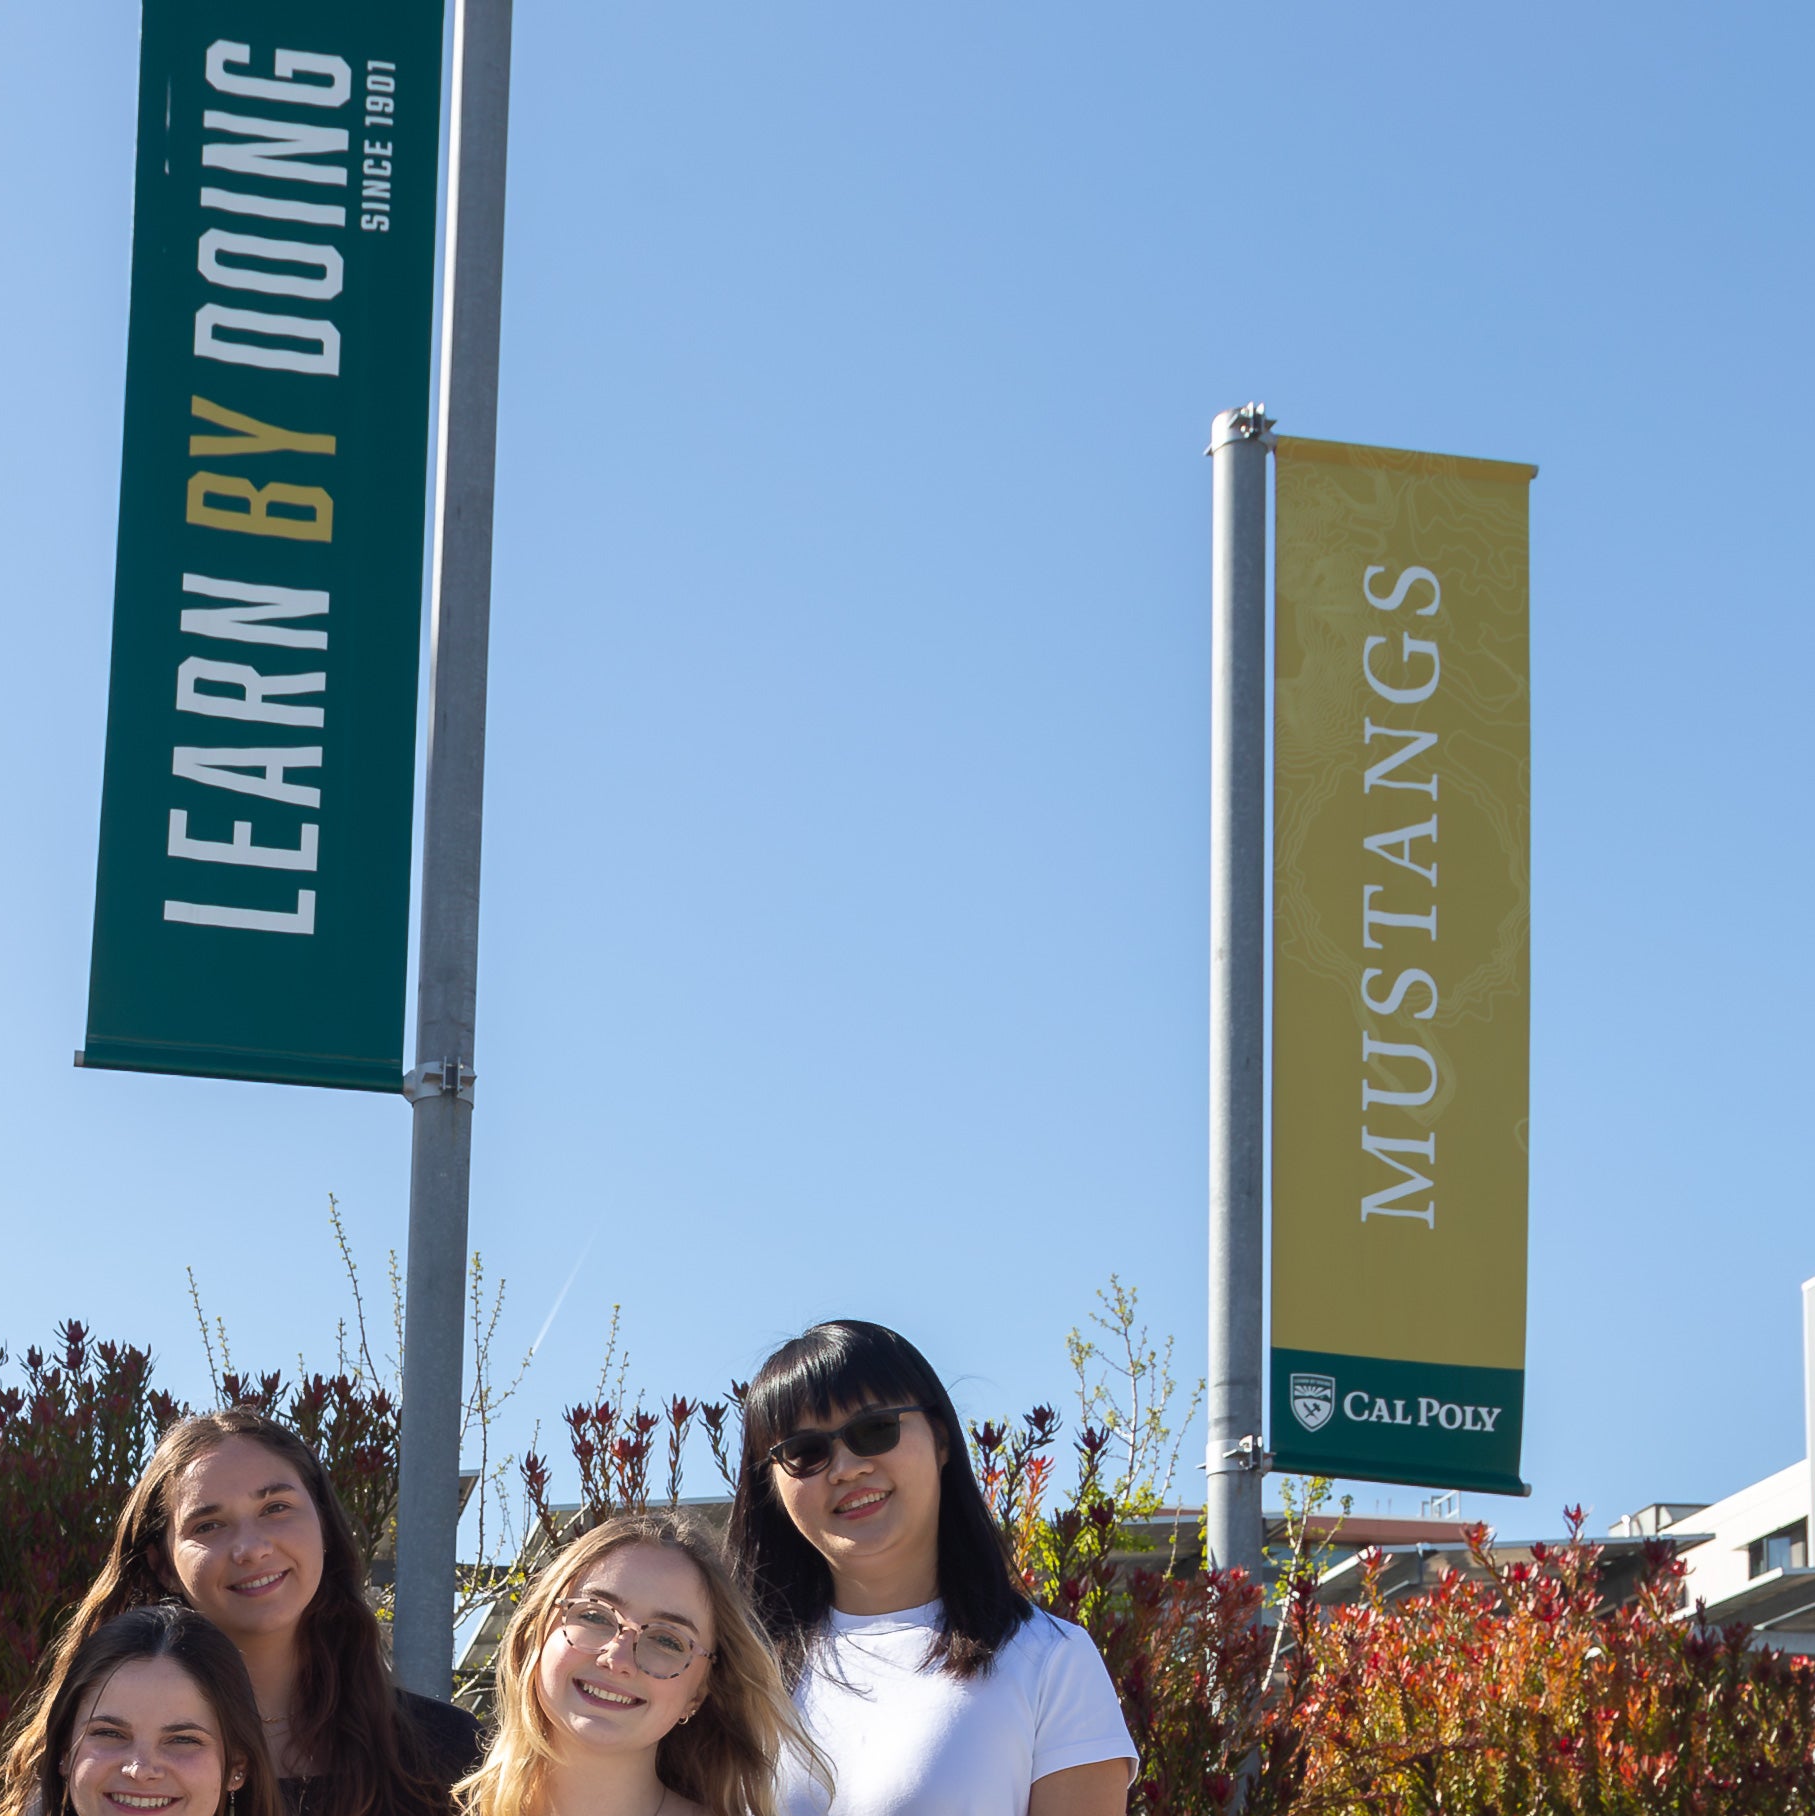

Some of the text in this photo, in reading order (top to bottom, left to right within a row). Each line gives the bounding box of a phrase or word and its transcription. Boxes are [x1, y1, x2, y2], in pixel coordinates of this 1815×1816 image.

[361, 61, 395, 231] SINCE 1901
[163, 39, 352, 935] LEARN BY DOING
[1360, 565, 1441, 1230] MUSTANGS
[1344, 1391, 1502, 1432] CAL POLY
